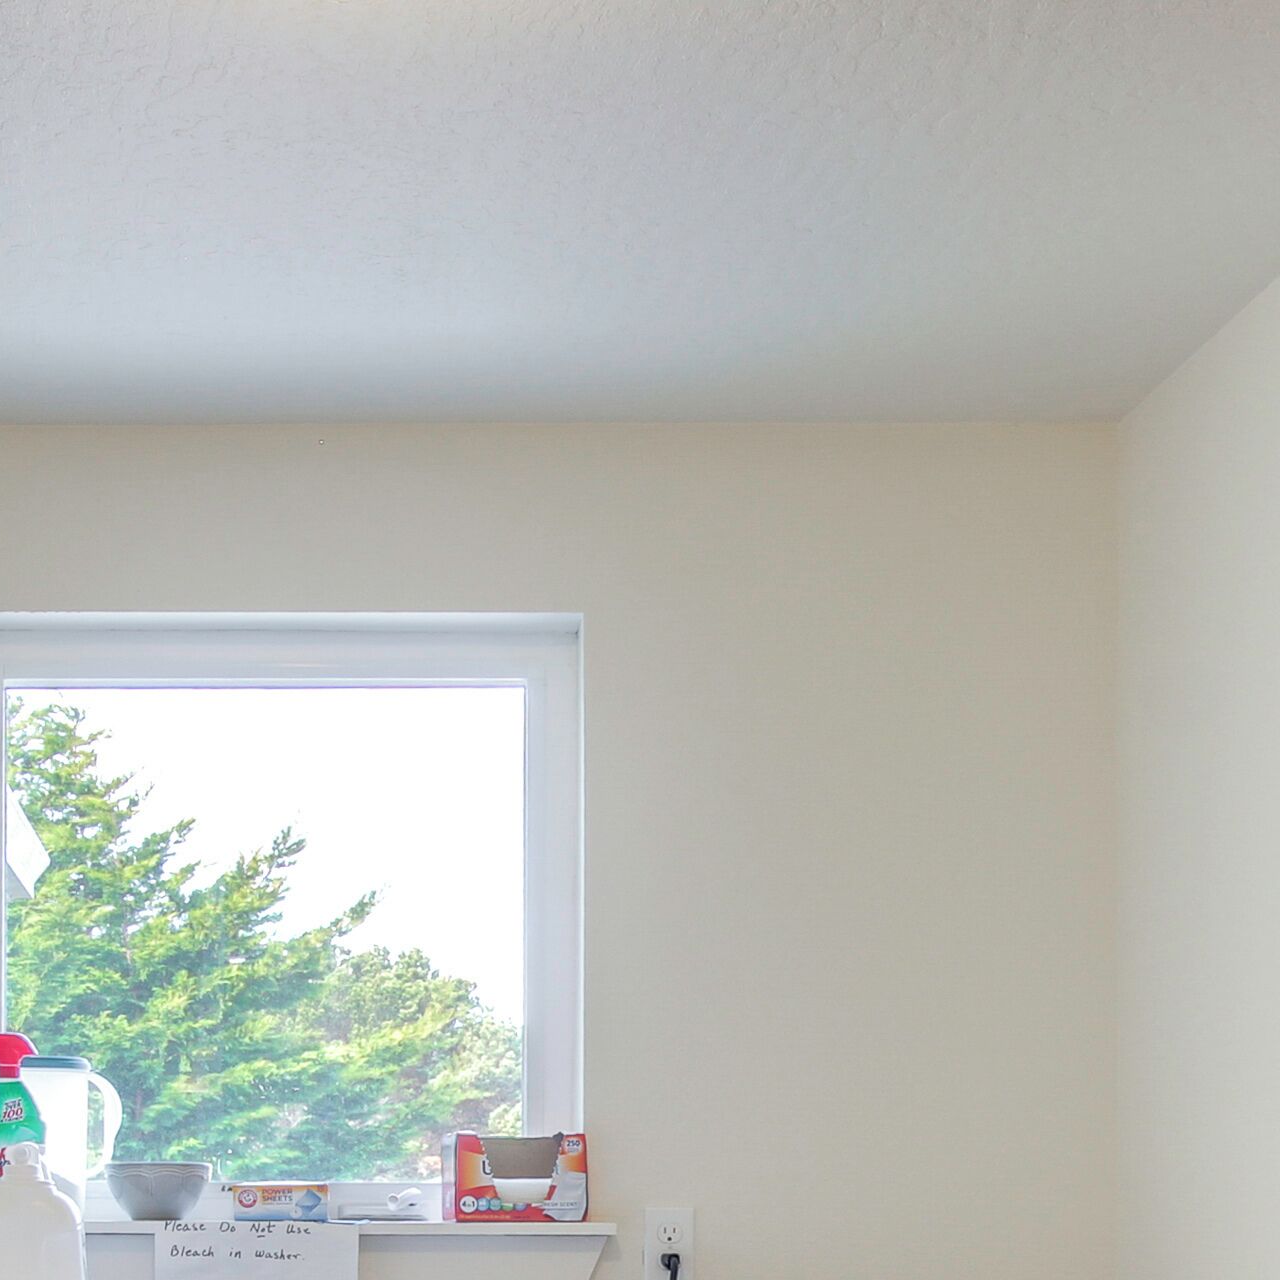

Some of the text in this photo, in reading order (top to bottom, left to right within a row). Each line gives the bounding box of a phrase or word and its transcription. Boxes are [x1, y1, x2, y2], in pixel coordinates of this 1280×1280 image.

[3, 1107, 23, 1119] 100
[164, 1221, 311, 1235] Please Do Not Use
[170, 1245, 215, 1258] Bleach
[229, 1248, 242, 1259] in
